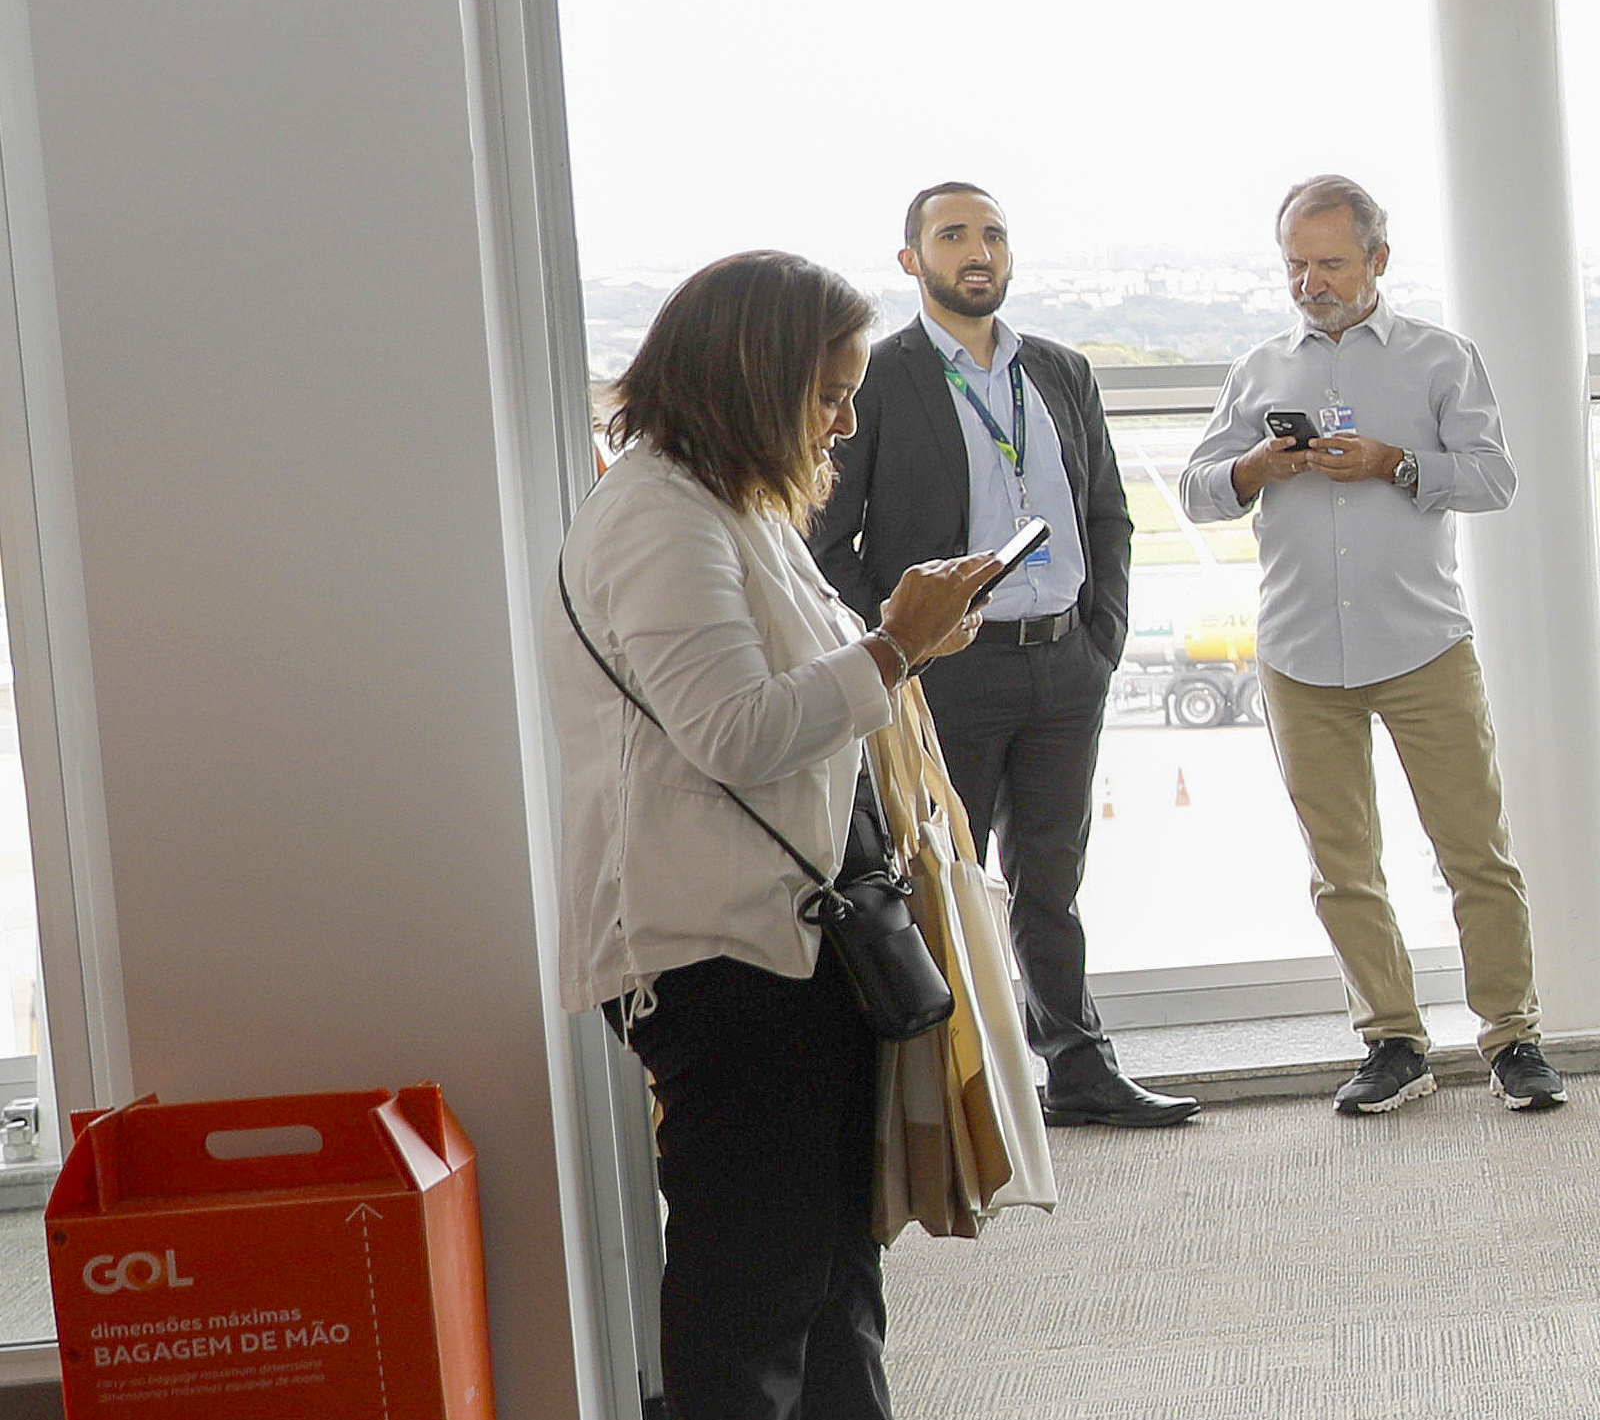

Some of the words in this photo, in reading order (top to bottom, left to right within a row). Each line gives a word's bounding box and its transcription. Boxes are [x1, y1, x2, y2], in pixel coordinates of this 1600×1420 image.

[83, 1248, 194, 1295] GOL
[90, 1315, 201, 1340] dimensões
[208, 1307, 301, 1330] máximas
[94, 1334, 232, 1367] BAGAGEM
[240, 1329, 278, 1354] DE
[286, 1320, 351, 1349] MÃO
